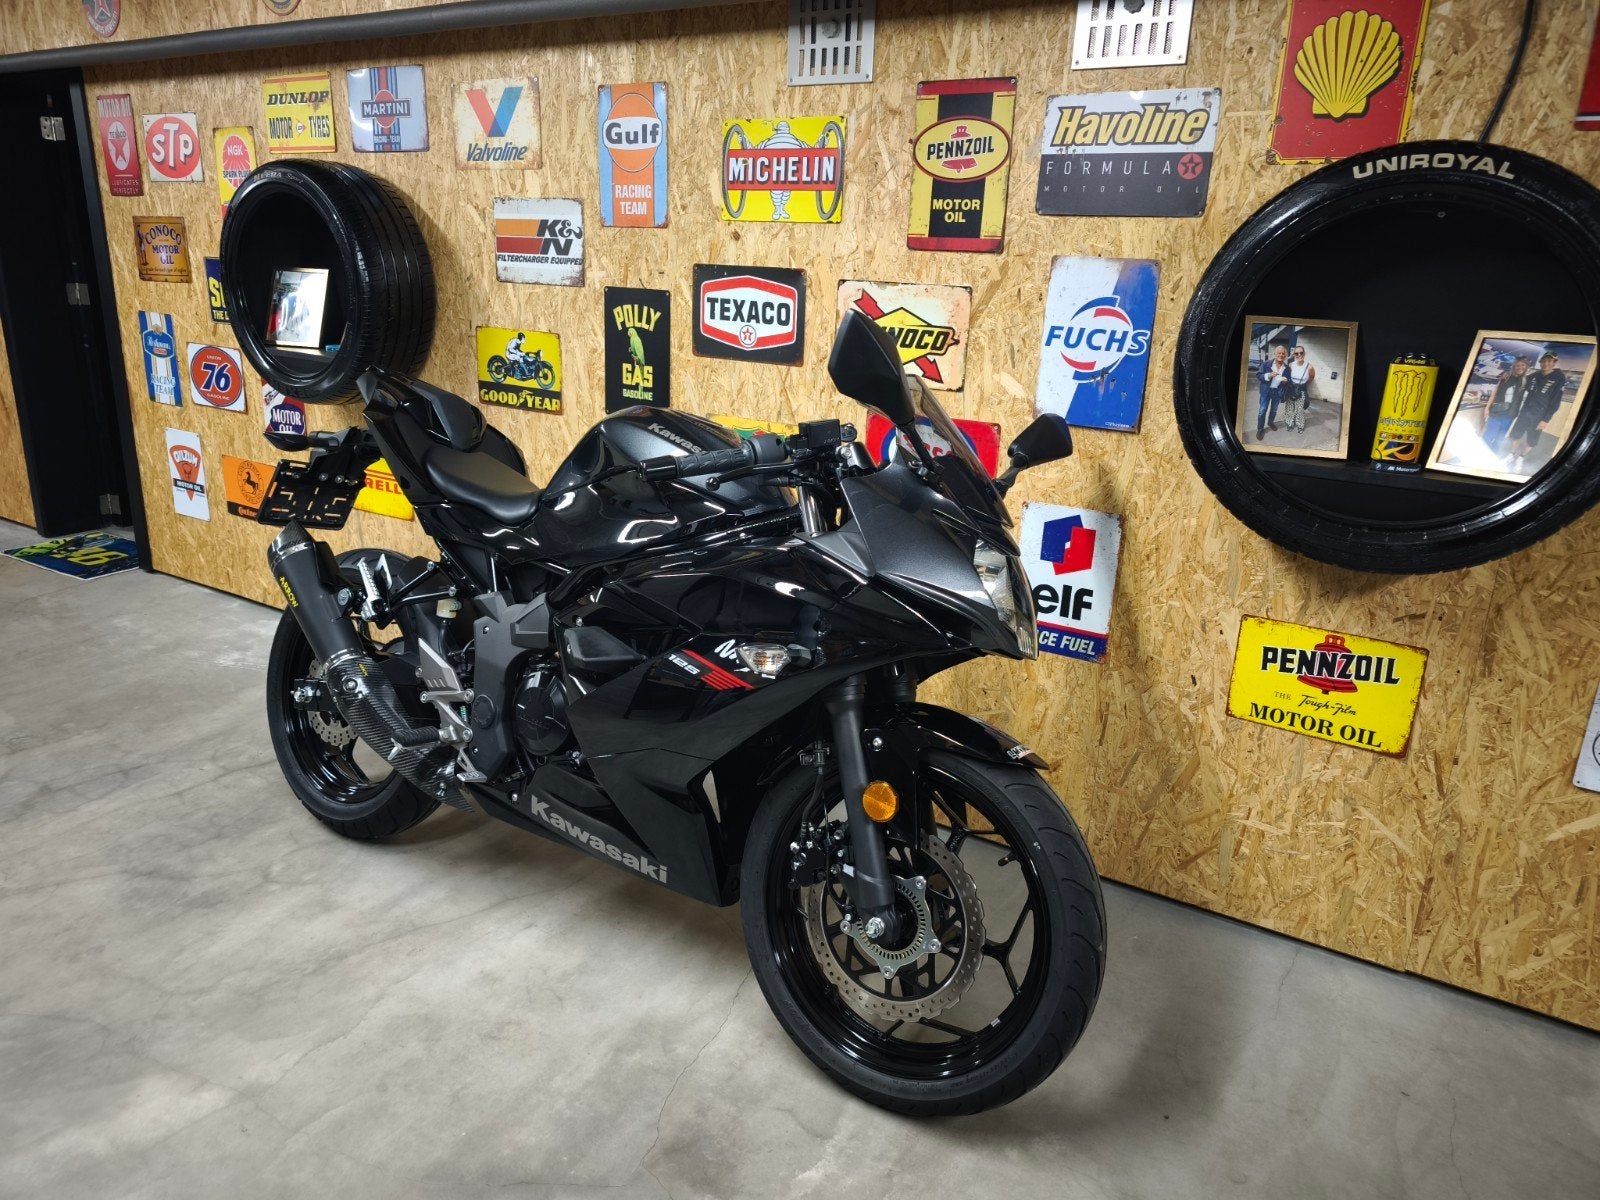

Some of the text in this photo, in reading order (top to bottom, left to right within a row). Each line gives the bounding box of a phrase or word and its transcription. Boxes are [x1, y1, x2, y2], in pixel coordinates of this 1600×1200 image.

[267, 90, 330, 105] DUNLOP
[363, 102, 408, 116] MARTINI
[269, 115, 331, 139] MOTOR TYRES
[605, 122, 660, 145] Gulf
[1050, 102, 1209, 147] Havoline
[152, 122, 194, 168] STP
[227, 145, 243, 156] NGK
[466, 142, 528, 162] Valvoline
[926, 136, 995, 161] PENNZOIL
[728, 156, 836, 184] MICHELIN
[1045, 160, 1172, 175] FORMULA
[1352, 152, 1516, 180] UNIROYAL
[615, 184, 652, 198] RACING
[1156, 186, 1200, 194] OIL
[619, 201, 647, 215] TEAM
[932, 199, 981, 212] MOTOR
[943, 210, 966, 223] OIL
[145, 224, 182, 245] CONOCO
[152, 244, 180, 255] MOTOR
[160, 255, 175, 265] OIL
[497, 254, 584, 266] FILTERCHARGER EQUIPPED
[613, 304, 662, 332] POLLY
[706, 296, 792, 326] TEXACO
[882, 326, 951, 351] NOCO
[1045, 325, 1150, 356] FUCHS
[200, 361, 231, 393] 76
[622, 362, 654, 388] GAS
[622, 388, 653, 401] GASOLINE
[272, 408, 302, 426] MOTOR
[648, 423, 707, 455] Kawas
[365, 477, 402, 495] RELL
[1031, 583, 1094, 621] elf
[1060, 635, 1095, 656] FUEL
[668, 653, 701, 675] 125
[1260, 646, 1400, 685] PENNZOIL
[1273, 691, 1357, 717] THE Tough-Film
[1249, 702, 1382, 748] MOTOR OIL
[531, 794, 669, 884] Kawasaki
